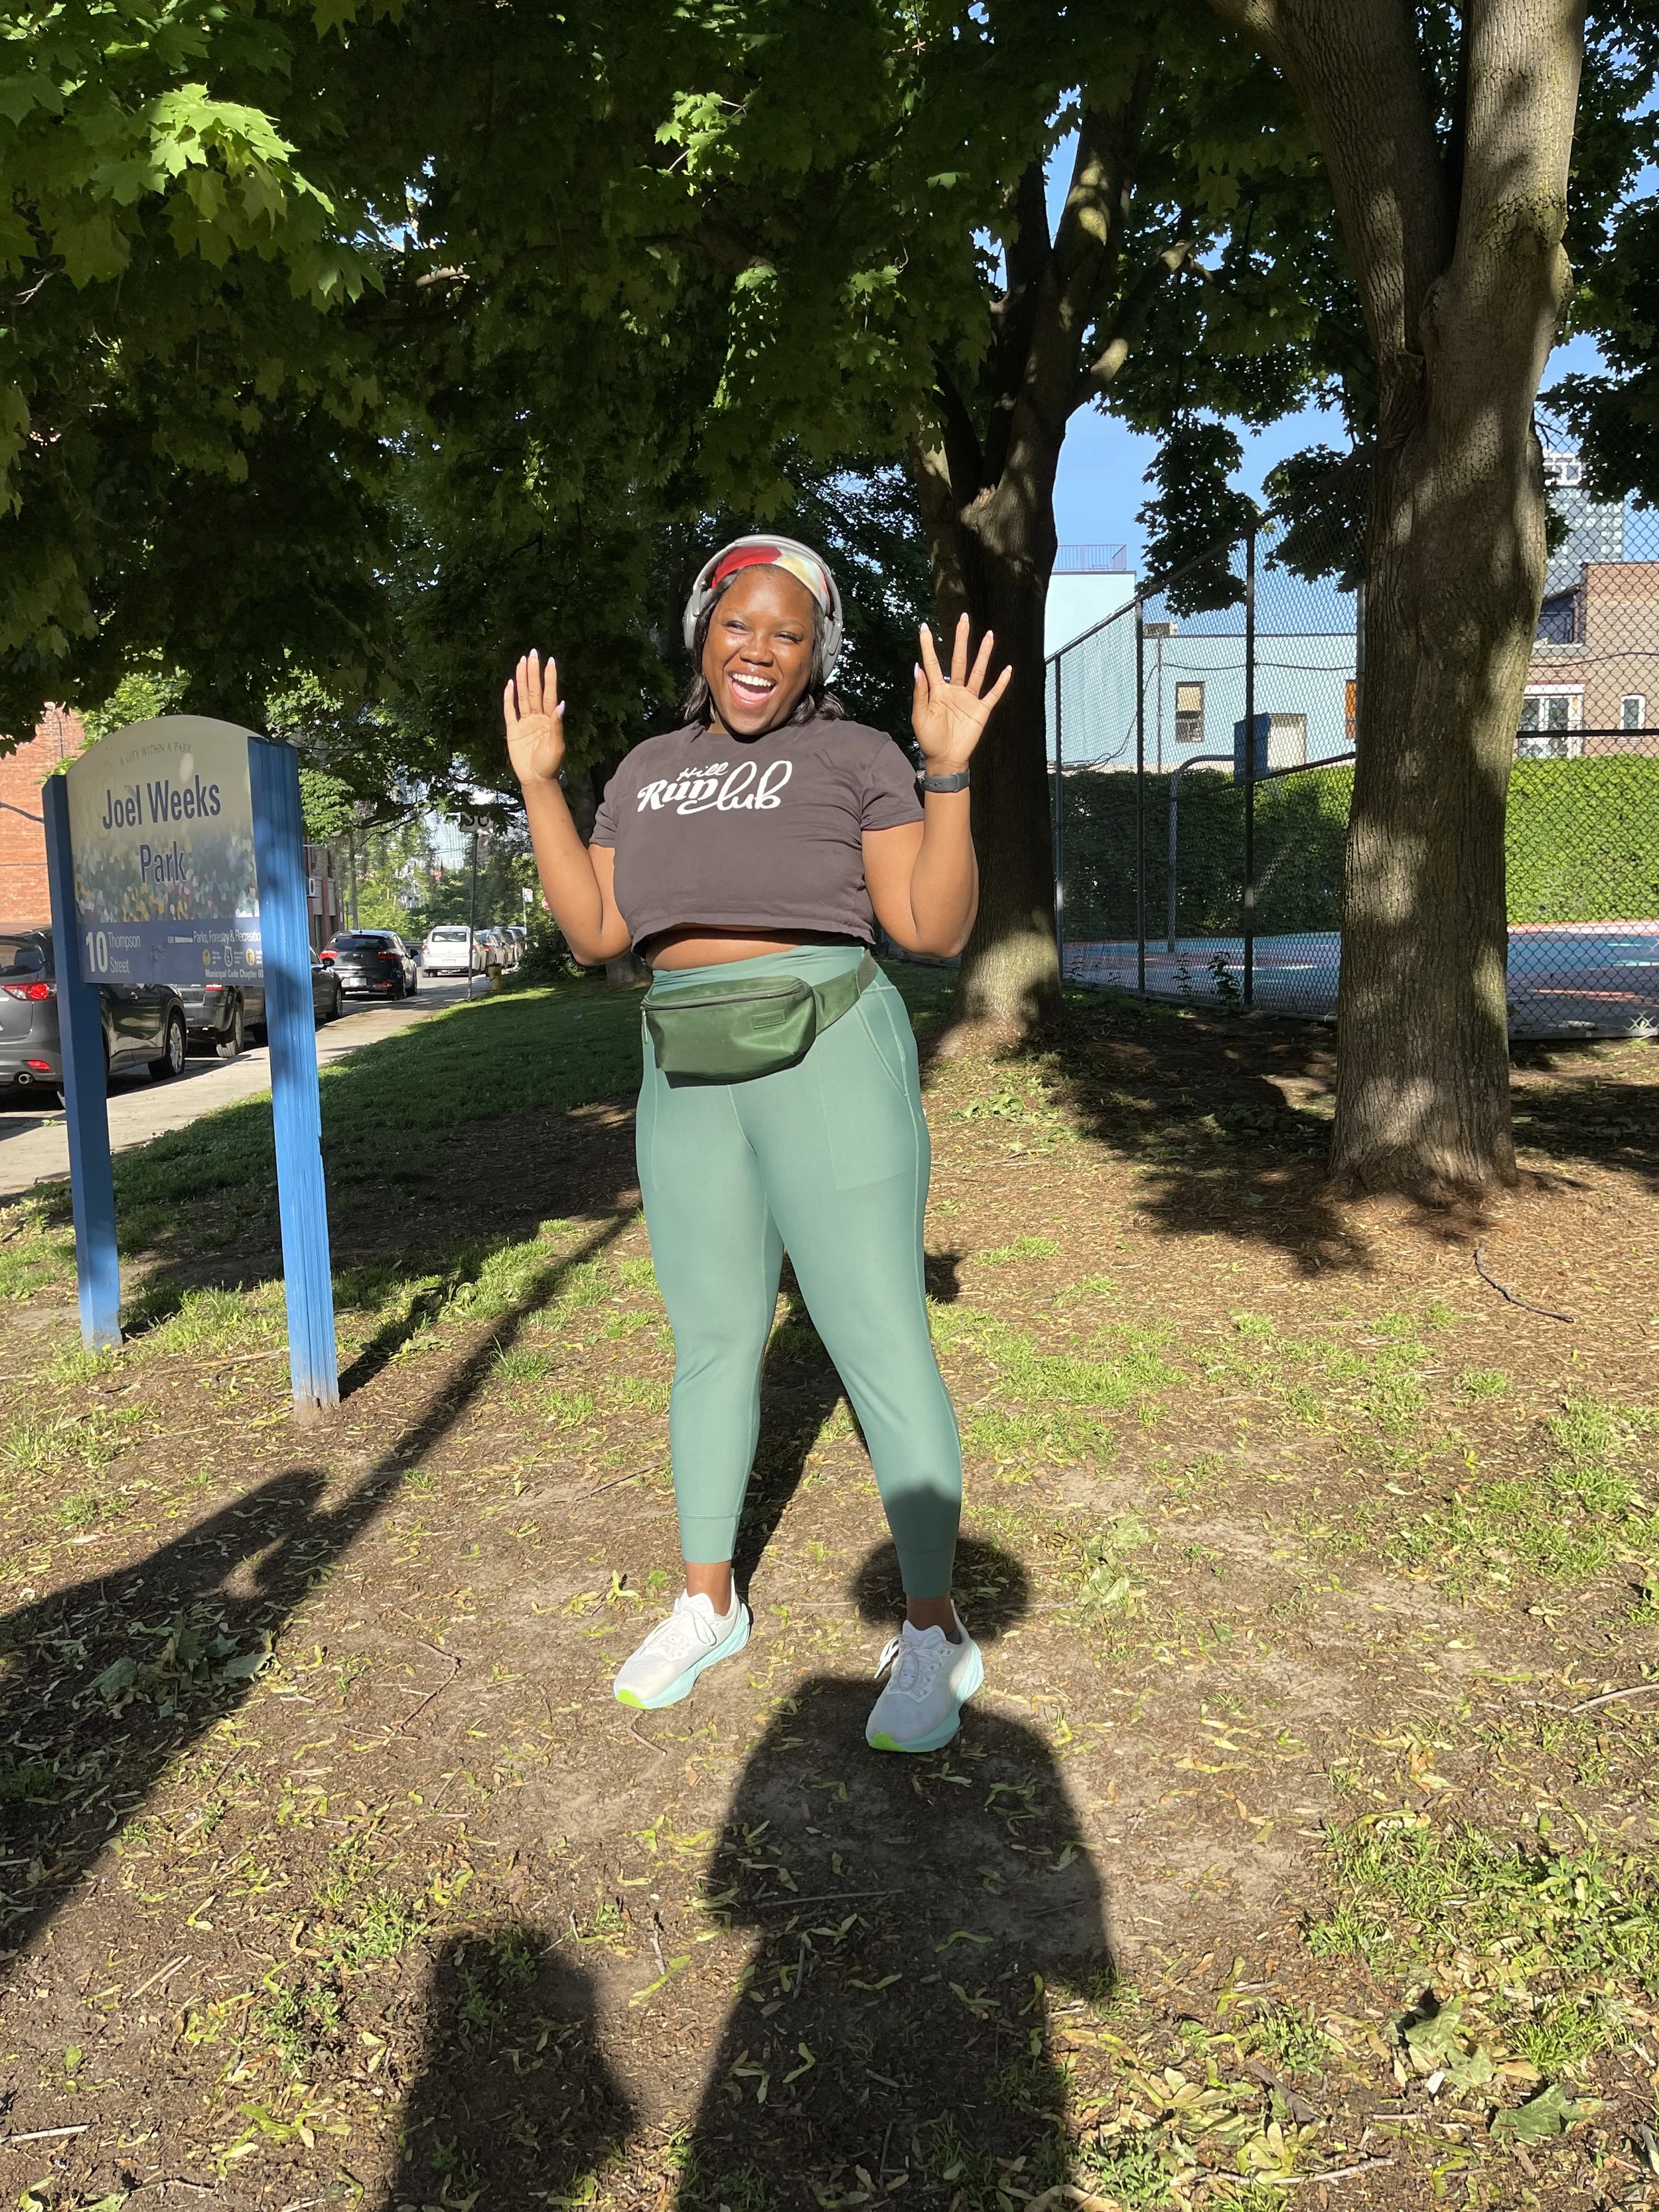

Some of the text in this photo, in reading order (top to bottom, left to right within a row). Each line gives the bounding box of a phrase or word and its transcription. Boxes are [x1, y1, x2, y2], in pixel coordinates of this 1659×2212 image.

[141, 745, 165, 756] WITHIN
[167, 743, 172, 752] A
[174, 742, 191, 754] PARK
[676, 761, 729, 782] Hill
[637, 760, 792, 815] Run Club
[102, 774, 220, 830] Joel Weeks
[139, 840, 186, 883] Park
[108, 932, 141, 951] Thompson
[193, 930, 208, 944] Parks,
[209, 930, 230, 945] Forestry
[230, 929, 235, 942] &
[235, 929, 261, 942] Recreatio
[86, 931, 108, 972] 10
[109, 957, 129, 973] Street
[205, 969, 227, 980] Municipal
[228, 969, 238, 978] Code
[240, 969, 257, 980] Chapter
